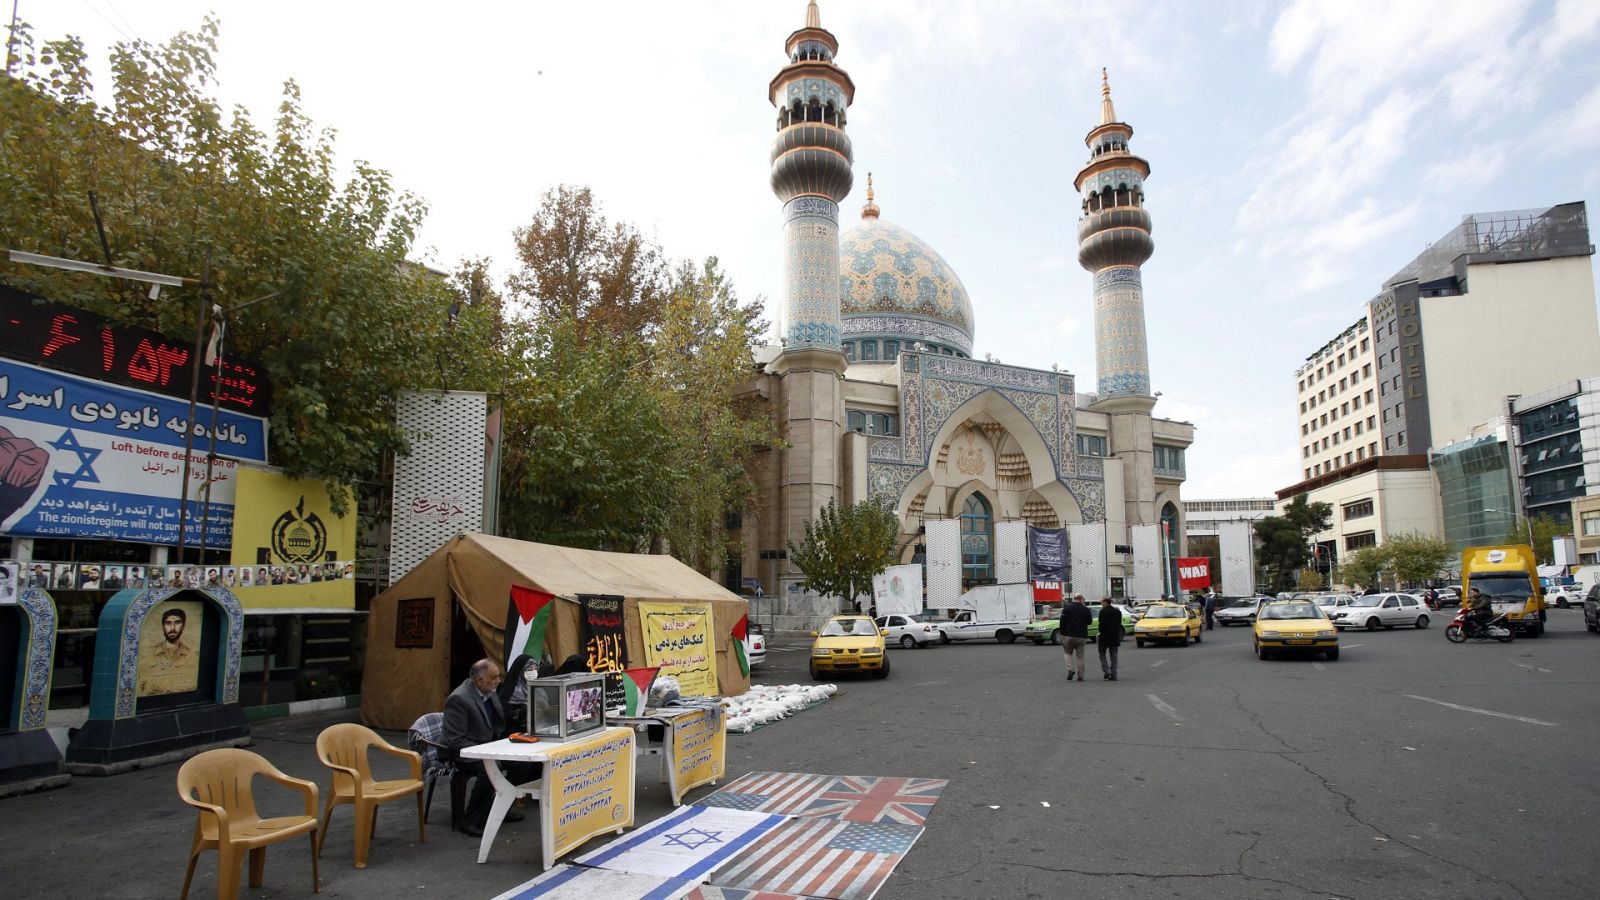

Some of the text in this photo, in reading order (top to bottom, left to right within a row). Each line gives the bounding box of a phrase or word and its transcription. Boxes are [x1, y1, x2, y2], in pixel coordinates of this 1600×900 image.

[1400, 302, 1423, 399] HOTEL
[71, 402, 160, 430] نابودی
[166, 416, 188, 438] به
[111, 441, 235, 469] Loft before detrucon of
[187, 466, 206, 480] زوا
[41, 498, 65, 509] دید
[67, 500, 110, 513] نخواهد
[112, 502, 123, 515] را
[155, 507, 175, 519] سال
[38, 511, 59, 522] The
[61, 513, 128, 528] zionistregime
[131, 519, 147, 529] will
[148, 522, 163, 531] not
[164, 523, 194, 533] surve
[210, 527, 226, 536] next
[1179, 564, 1208, 579] WAR
